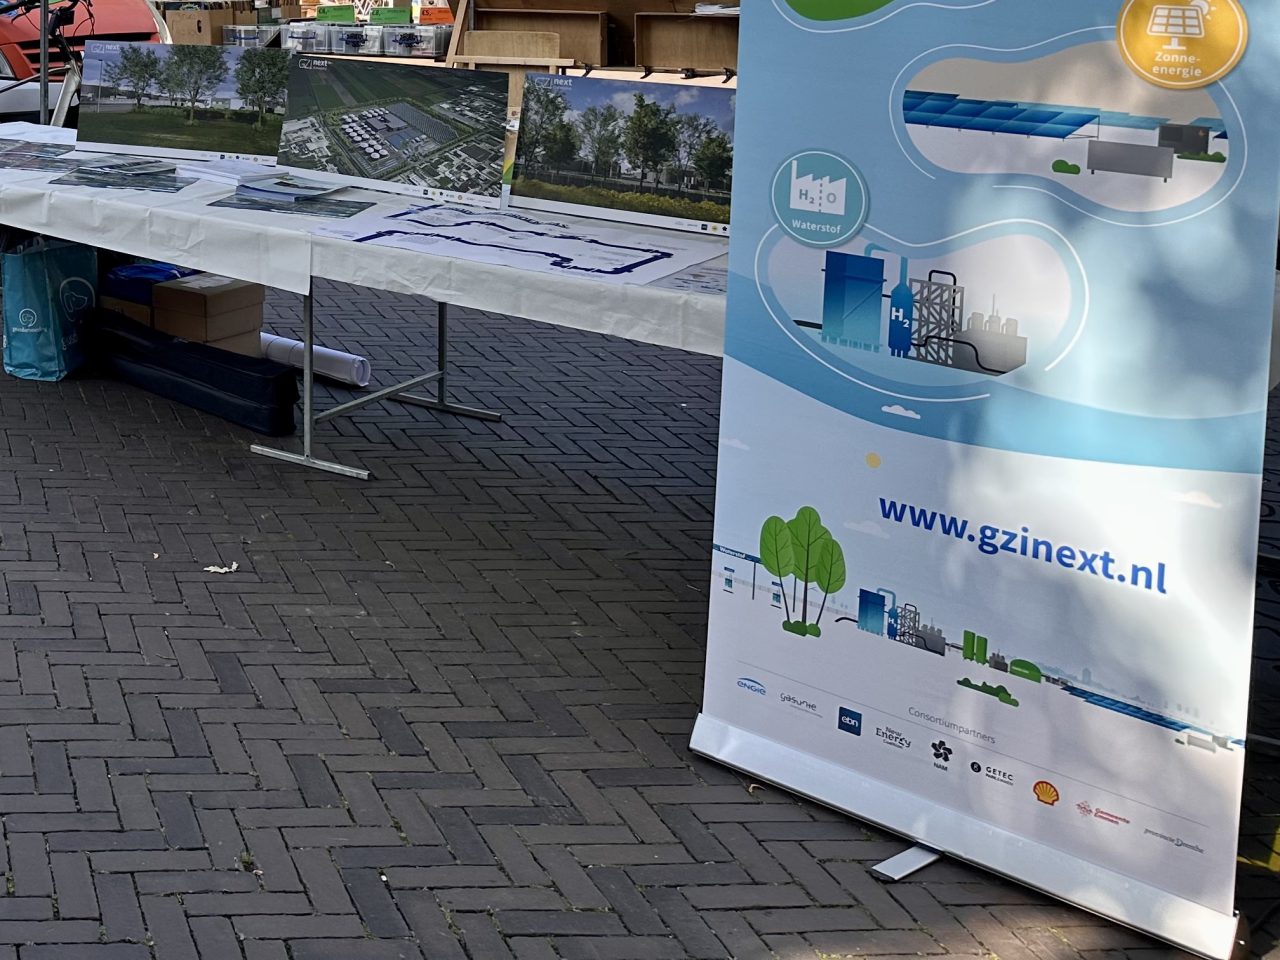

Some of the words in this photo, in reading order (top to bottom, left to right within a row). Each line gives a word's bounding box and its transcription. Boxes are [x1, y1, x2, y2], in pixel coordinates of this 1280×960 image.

[1154, 51, 1201, 64] Zonne-
[1152, 66, 1202, 78] energie
[791, 219, 842, 234] Waterstof
[878, 497, 1167, 594] www.gzinext.nl
[841, 715, 859, 728] ebn
[908, 706, 996, 744] Consortiumpartners
[875, 727, 912, 748] Energy
[885, 726, 903, 737] New
[933, 762, 948, 772] NAM
[985, 766, 1014, 781] GETEC
